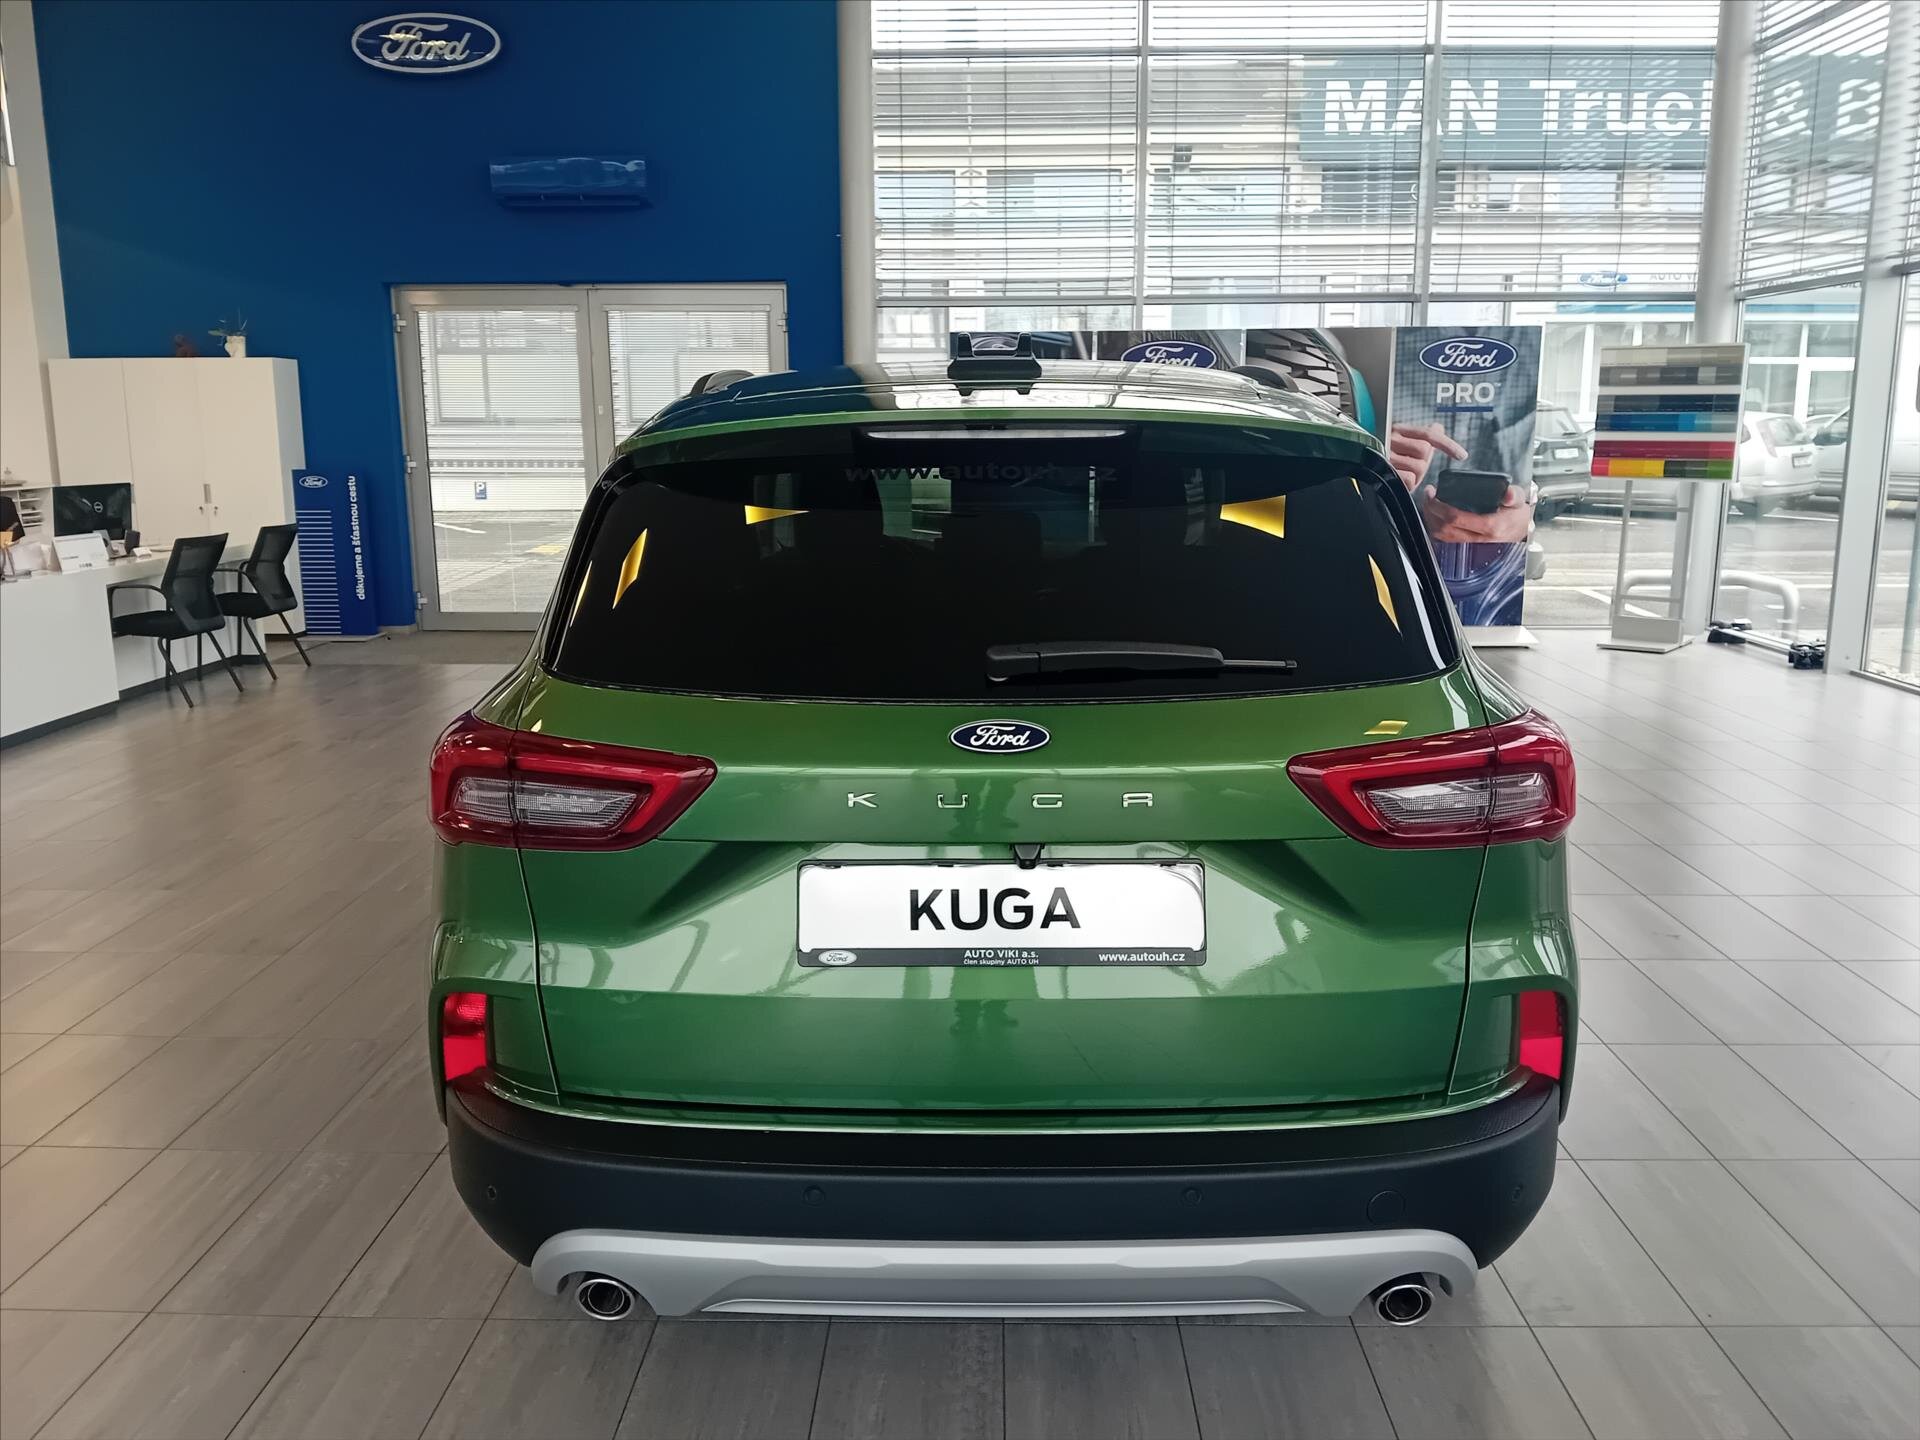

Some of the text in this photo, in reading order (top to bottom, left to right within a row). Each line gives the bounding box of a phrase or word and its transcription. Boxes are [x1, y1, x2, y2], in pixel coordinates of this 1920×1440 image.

[381, 22, 470, 61] Ford
[1324, 79, 1499, 136] MAN
[1138, 345, 1199, 367] Ford
[1437, 341, 1499, 368] Ford
[1436, 382, 1496, 404] PRO
[347, 475, 357, 502] cestu
[355, 554, 366, 600] děkujeme
[969, 721, 1031, 748] Ford
[847, 791, 1154, 809] KUGA
[908, 886, 1082, 931] KUGA
[826, 952, 849, 962] Ford
[964, 949, 1039, 959] AUTO VIKI a.s.
[979, 958, 1006, 966] skupiny
[1098, 952, 1186, 963] www.autouh.cz
